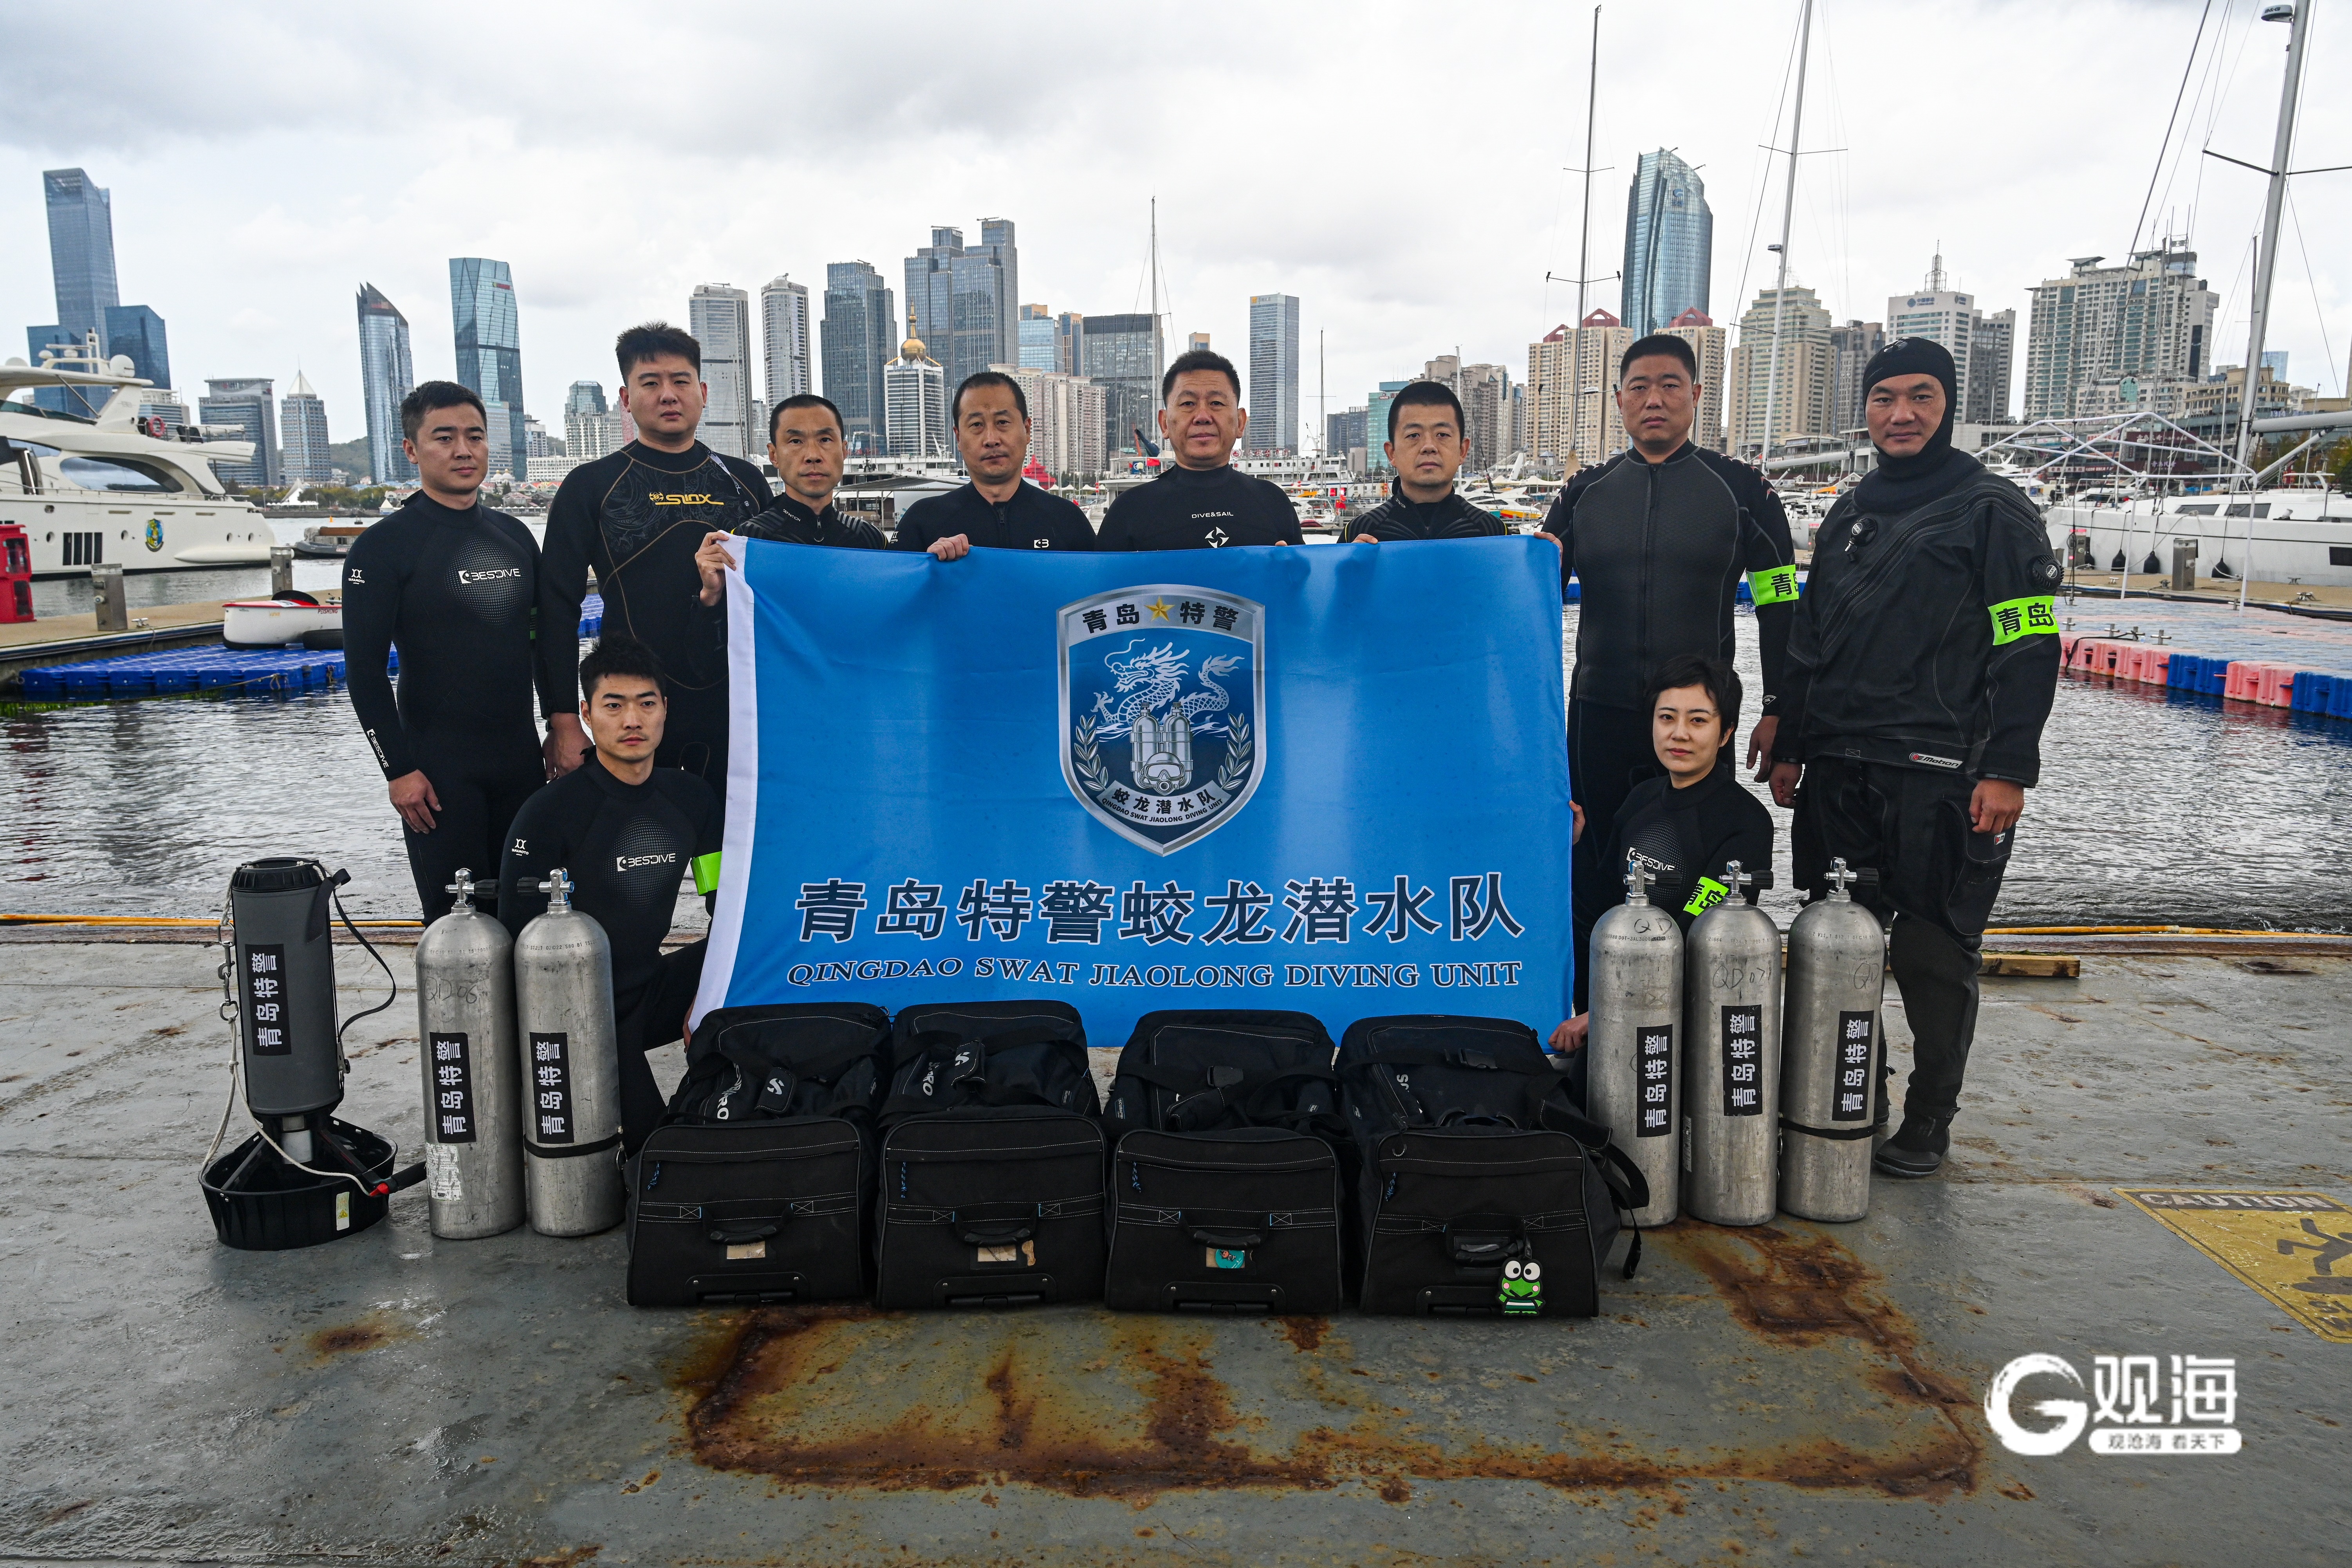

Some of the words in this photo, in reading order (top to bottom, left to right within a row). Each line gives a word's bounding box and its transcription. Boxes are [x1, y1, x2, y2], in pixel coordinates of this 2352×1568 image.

[783, 509, 801, 521] DEFINITION
[471, 568, 521, 580] BESDIVE
[1082, 603, 1140, 633] 青岛
[1179, 601, 1240, 631] 特警
[1996, 602, 2054, 635] 青岛
[370, 736, 389, 768] BESDIVE
[1101, 797, 1130, 816] QINGDAO
[1130, 811, 1148, 821] SWAT
[1148, 814, 1184, 823] JIAOLONG
[1185, 807, 1208, 821] DIVING
[1208, 797, 1224, 810] UNIT
[1111, 787, 1217, 815] 蛟龙潜水队
[628, 853, 676, 867] BESDIVE
[794, 872, 1526, 946] 青岛特警蛟龙潜水队
[786, 956, 962, 986] QINGDAO
[974, 957, 1079, 985] SWAT
[1088, 961, 1273, 987] JIAOLONG
[1283, 961, 1418, 987] DIVING
[1431, 960, 1523, 987] UNIT
[1713, 964, 1744, 989] QD
[252, 953, 283, 1047] 青岛特警
[1730, 1014, 1756, 1107] 青岛特警
[1841, 1019, 1869, 1112] 青岛特警
[436, 1041, 467, 1135] 青岛特警
[536, 1041, 566, 1135] 青岛特警
[1644, 1035, 1668, 1128] 青岛特警
[2139, 1194, 2334, 1208] CAUTION
